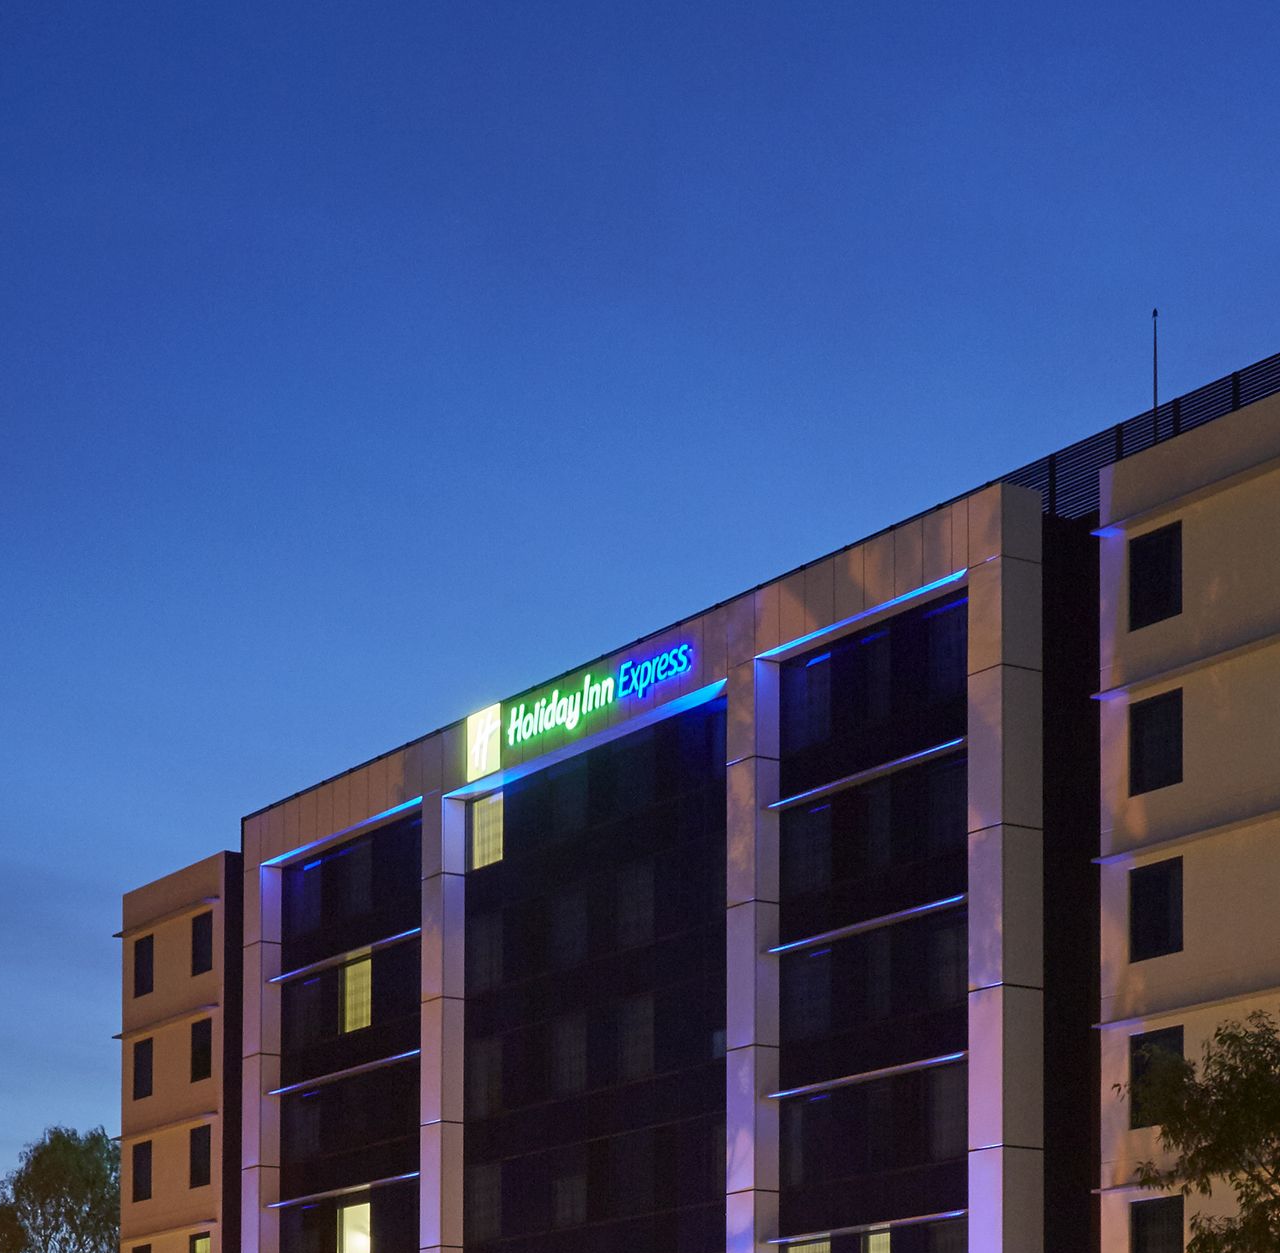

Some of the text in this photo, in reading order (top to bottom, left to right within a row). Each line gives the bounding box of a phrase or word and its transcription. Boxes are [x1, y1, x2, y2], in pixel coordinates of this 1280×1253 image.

[507, 689, 581, 747] Holiday
[582, 673, 615, 714] Inn
[618, 643, 690, 698] Express
